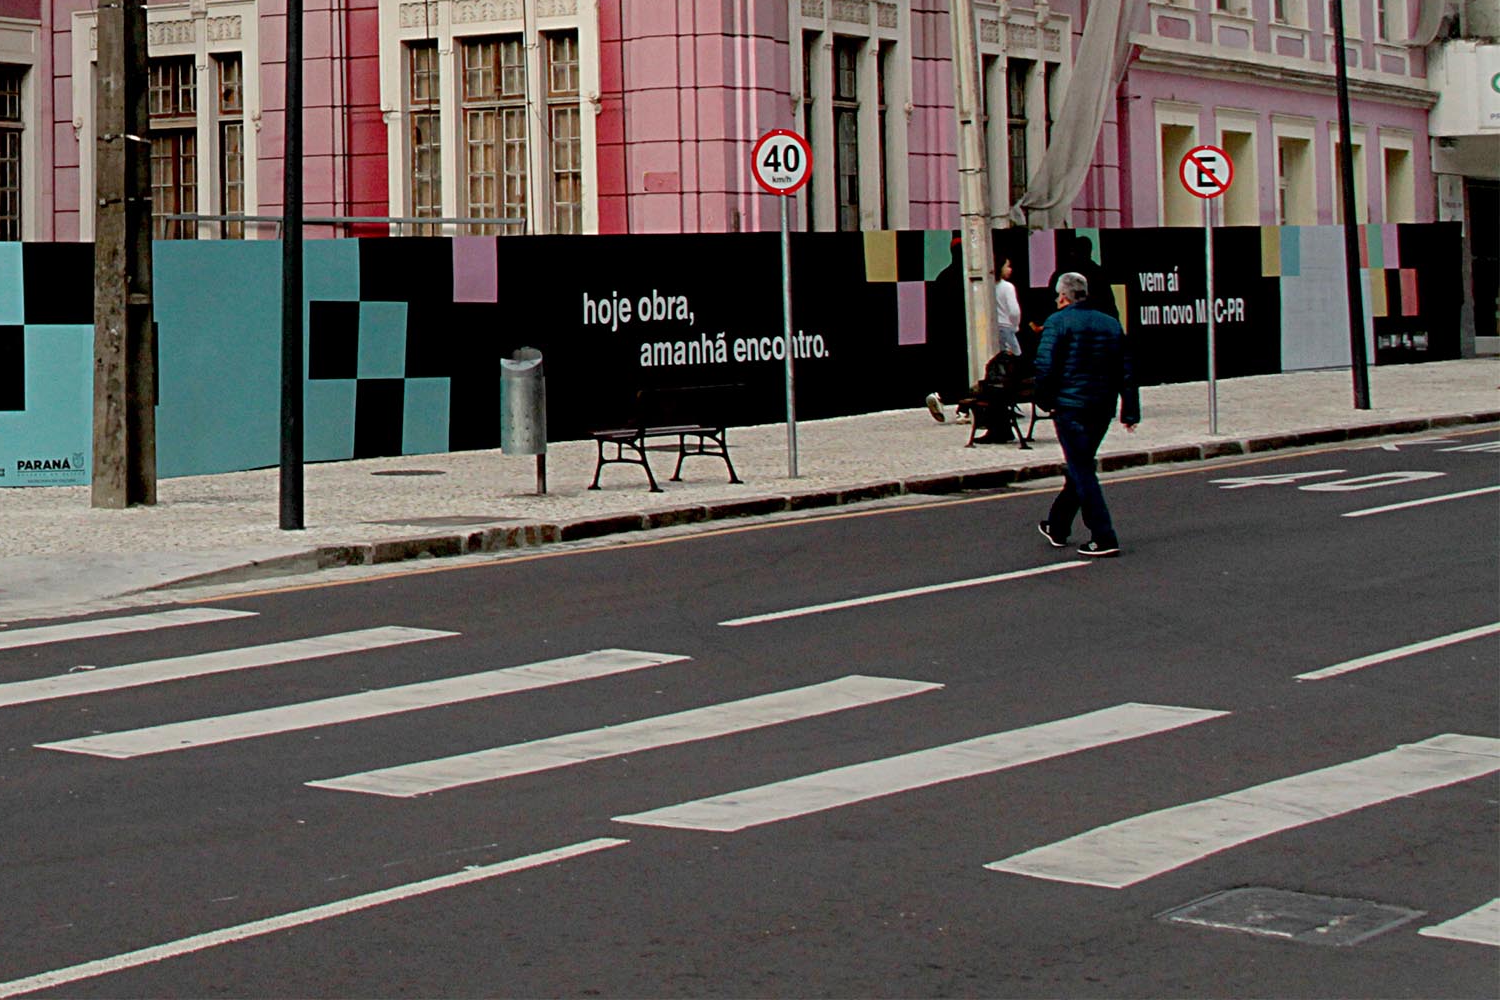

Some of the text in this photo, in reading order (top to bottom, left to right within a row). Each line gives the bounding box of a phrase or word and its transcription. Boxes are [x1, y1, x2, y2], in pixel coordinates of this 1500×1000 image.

[763, 144, 800, 172] 40
[1197, 156, 1216, 187] E
[1139, 265, 1179, 292] vem aí
[583, 289, 695, 332] hoje obra,
[1140, 297, 1245, 325] um novo MC-PR
[640, 332, 728, 366] amanhã
[17, 457, 71, 470] PARANÁ
